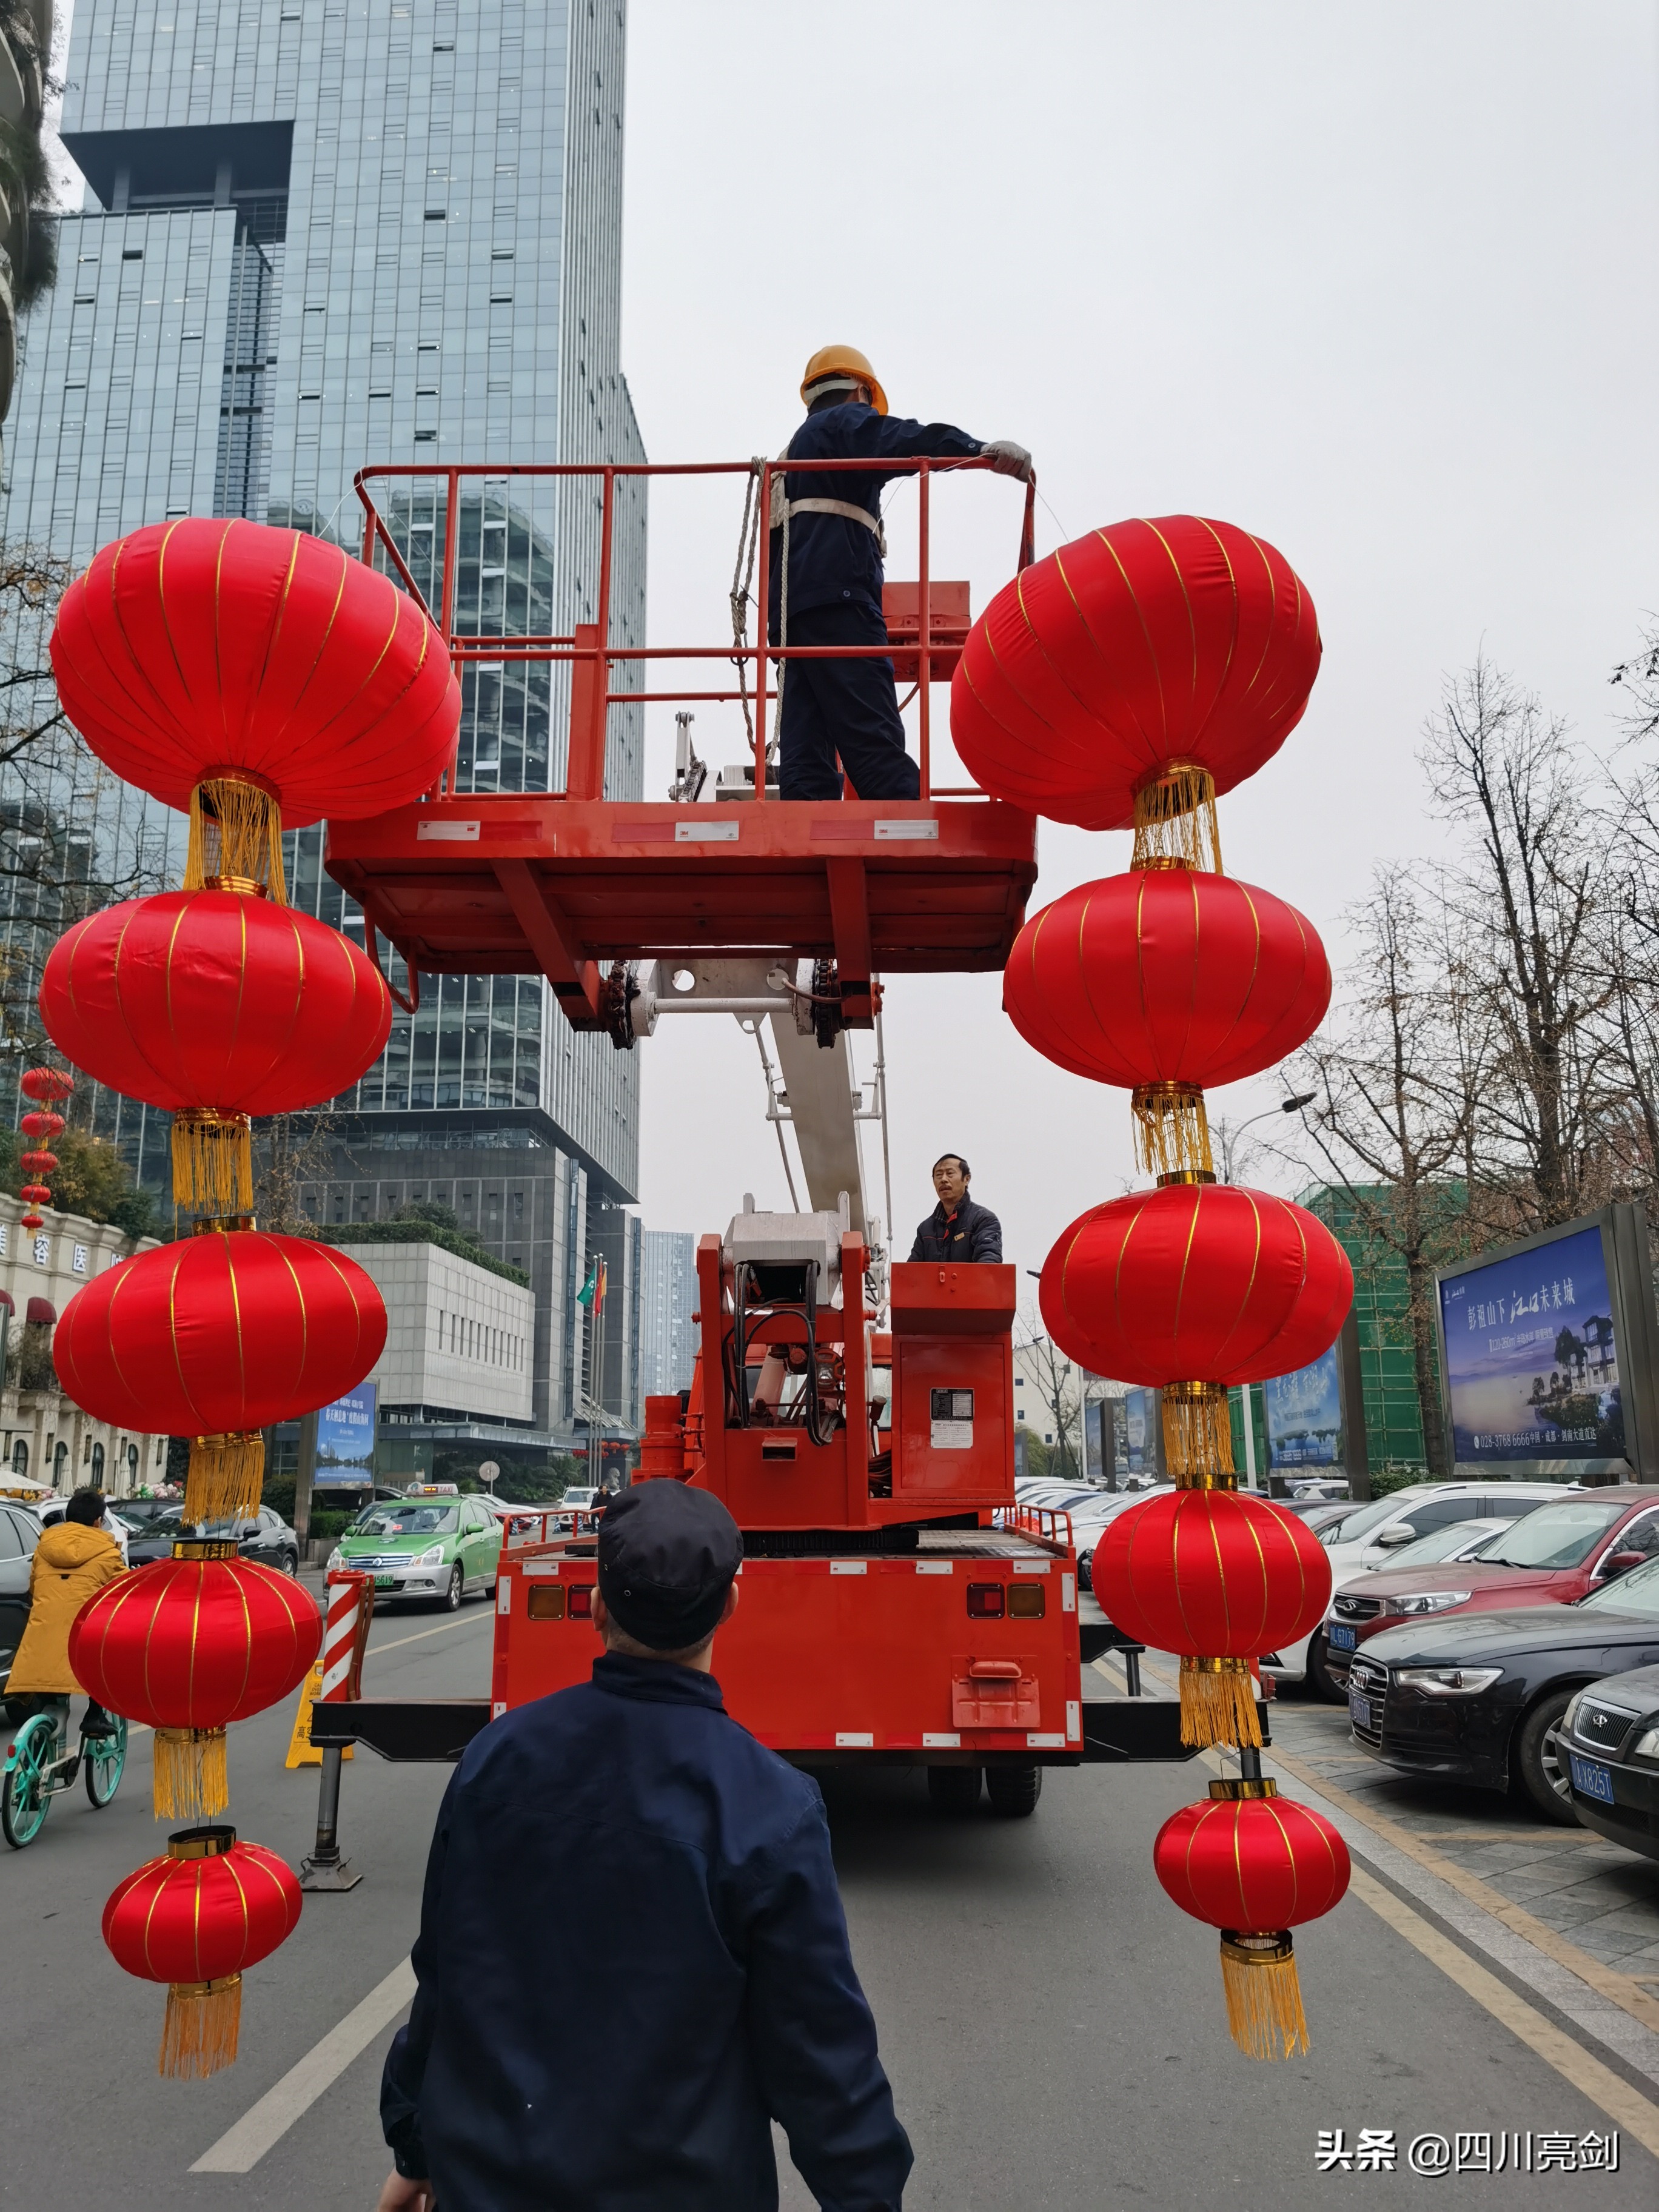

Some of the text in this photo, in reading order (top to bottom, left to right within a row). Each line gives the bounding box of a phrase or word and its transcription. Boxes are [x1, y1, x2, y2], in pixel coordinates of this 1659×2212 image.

[1467, 1298, 1504, 1331] 彭祖山下
[1512, 1432, 1530, 1446] 6666
